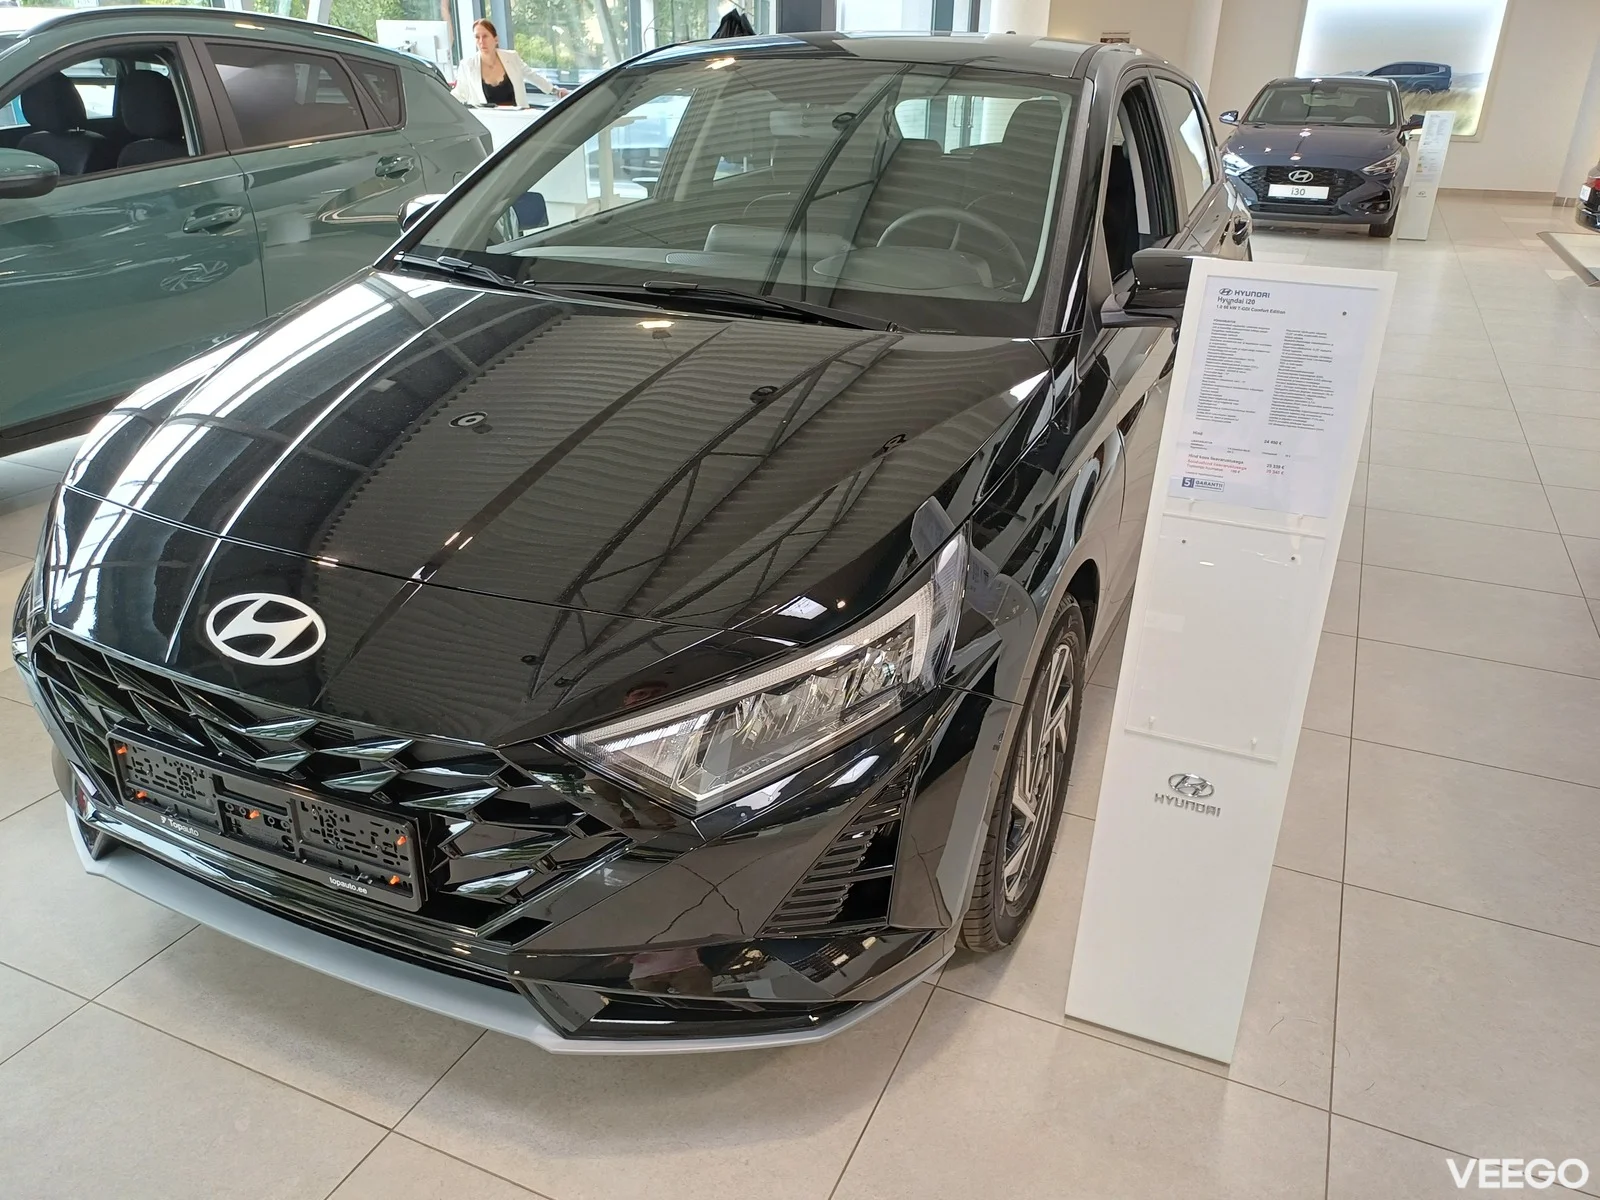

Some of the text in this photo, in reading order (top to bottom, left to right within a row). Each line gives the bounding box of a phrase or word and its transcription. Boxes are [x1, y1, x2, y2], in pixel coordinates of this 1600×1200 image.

[1291, 187, 1306, 196] i30
[1217, 296, 1245, 305] Hyundai
[1234, 290, 1270, 298] HYUNDAI
[1154, 793, 1221, 818] HYUNDAI
[168, 819, 200, 837] Topauto
[329, 876, 368, 895] topauto.ee
